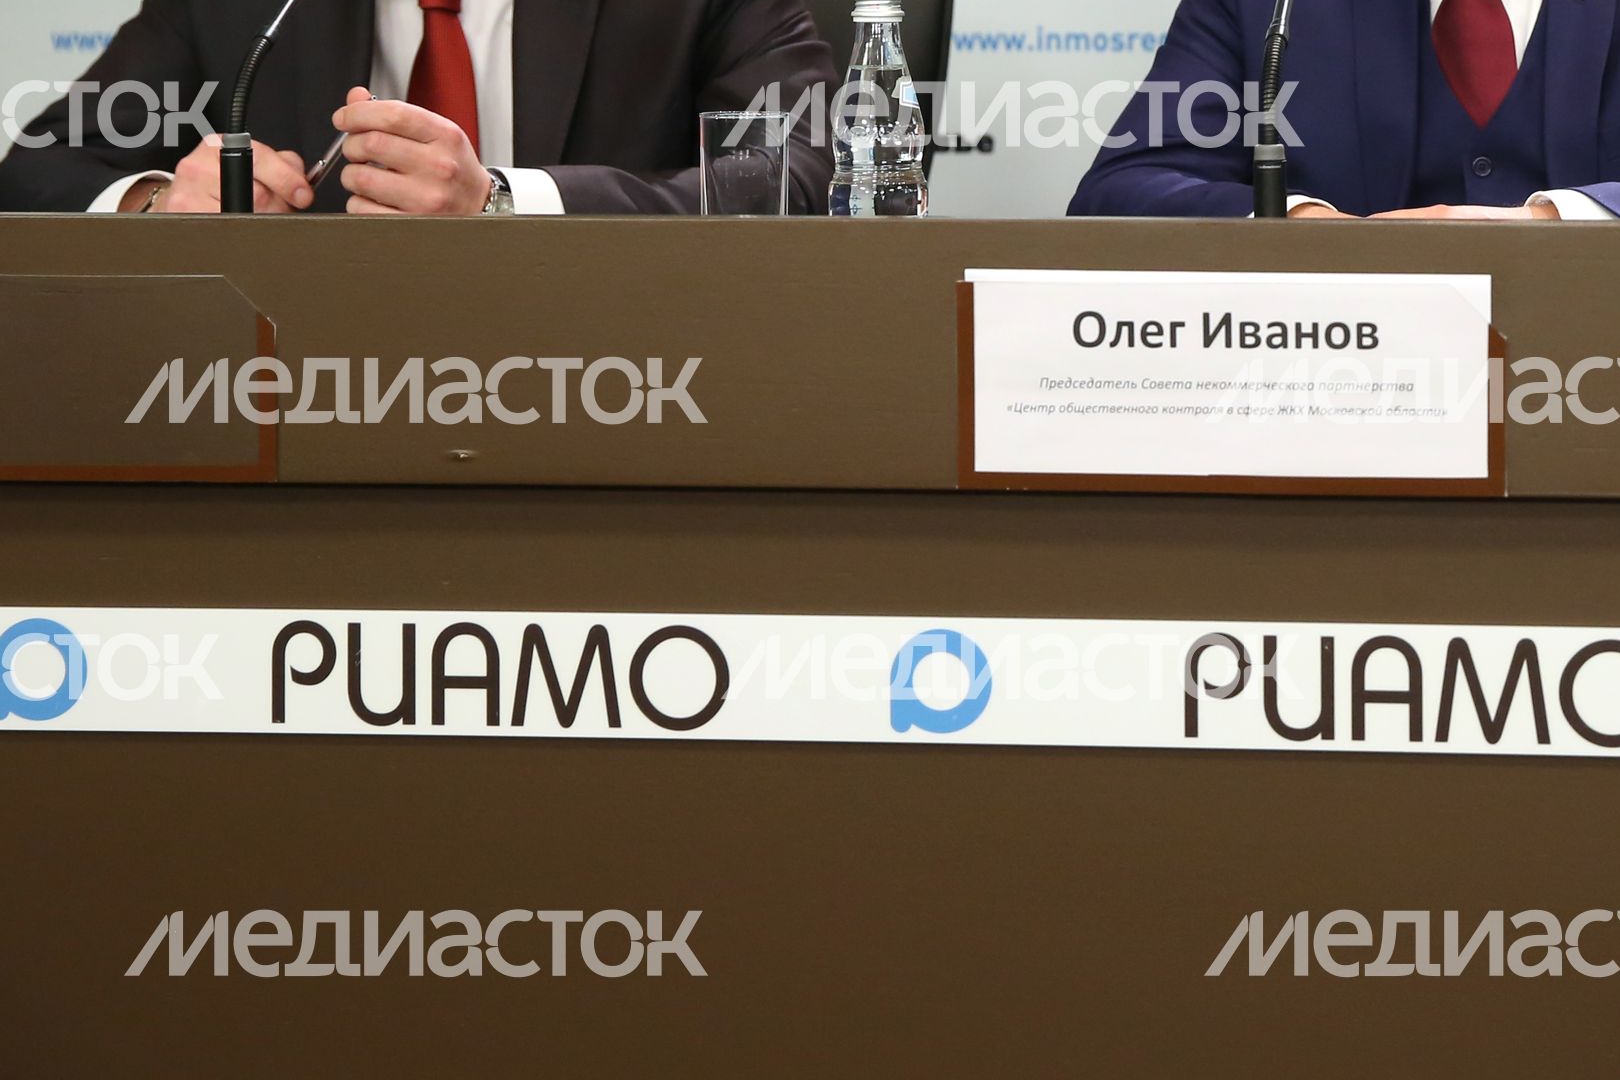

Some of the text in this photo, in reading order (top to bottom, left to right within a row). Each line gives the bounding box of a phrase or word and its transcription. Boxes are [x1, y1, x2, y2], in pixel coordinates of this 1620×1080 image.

[952, 25, 1168, 52] www.inmosre
[1072, 311, 1380, 350] Олег Иванов
[1039, 376, 1138, 392] Председатель
[1141, 377, 1193, 391] Совета
[1006, 402, 1056, 415] «Центр
[1058, 402, 1159, 416] общественного
[271, 619, 730, 731] РИАМО
